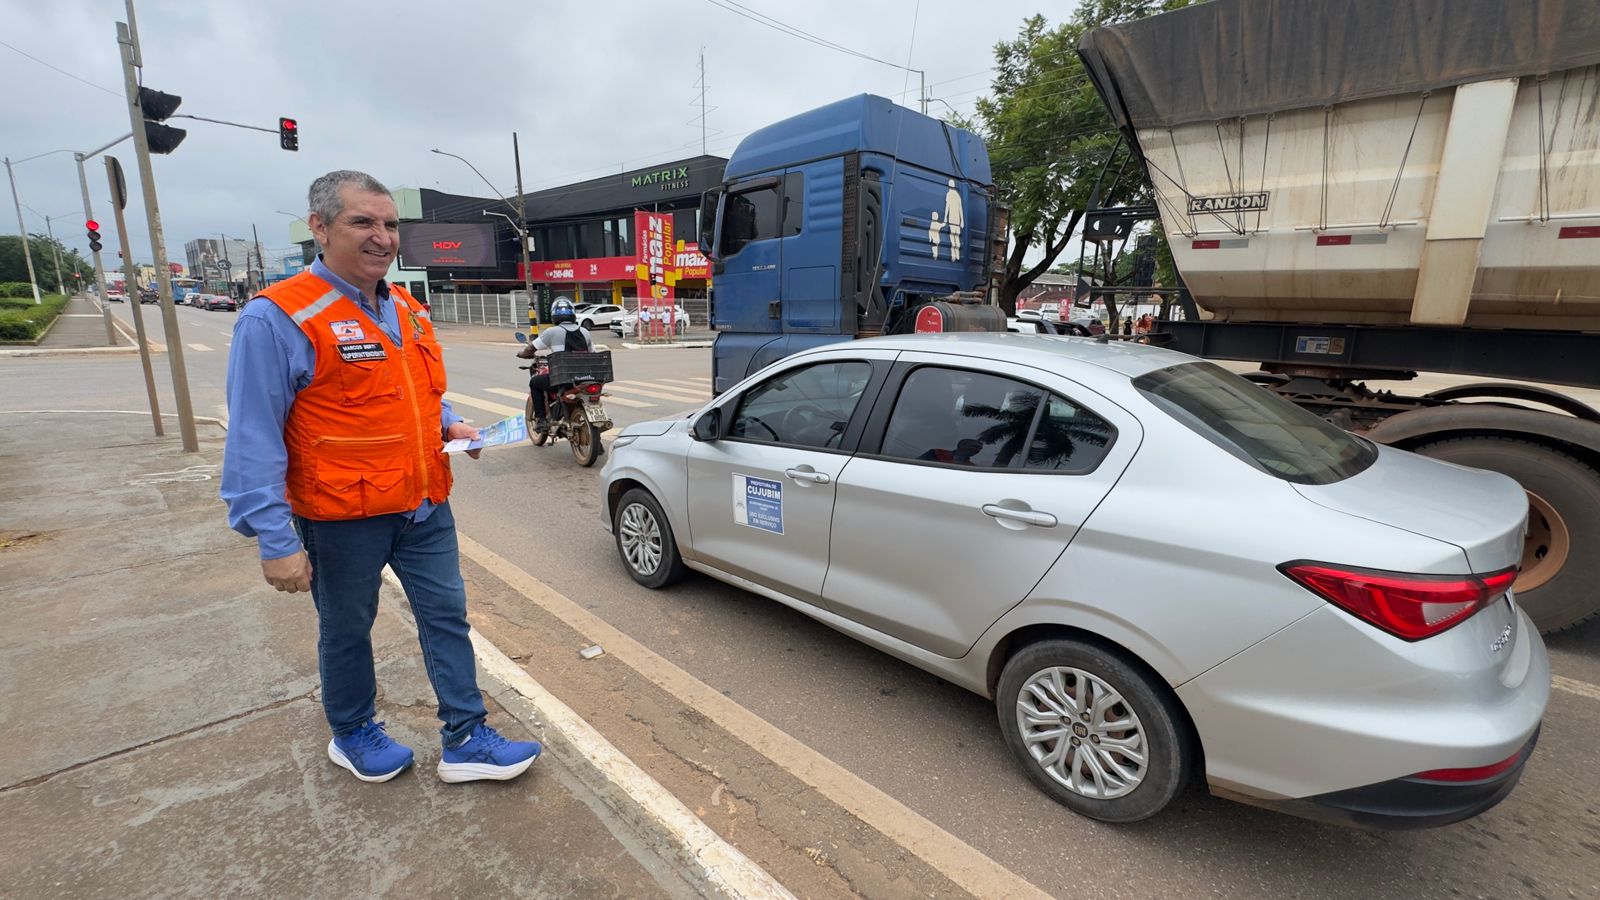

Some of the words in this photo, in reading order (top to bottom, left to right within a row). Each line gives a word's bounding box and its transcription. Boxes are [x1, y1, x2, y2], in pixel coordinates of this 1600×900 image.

[632, 167, 688, 187] MATRIX
[661, 180, 689, 190] FITNESS
[1191, 195, 1265, 211] RANDON
[432, 241, 462, 249] HDV
[664, 220, 673, 265] Popular
[747, 485, 780, 499] CUJUBIM
[1074, 725, 1086, 736] FIAT
